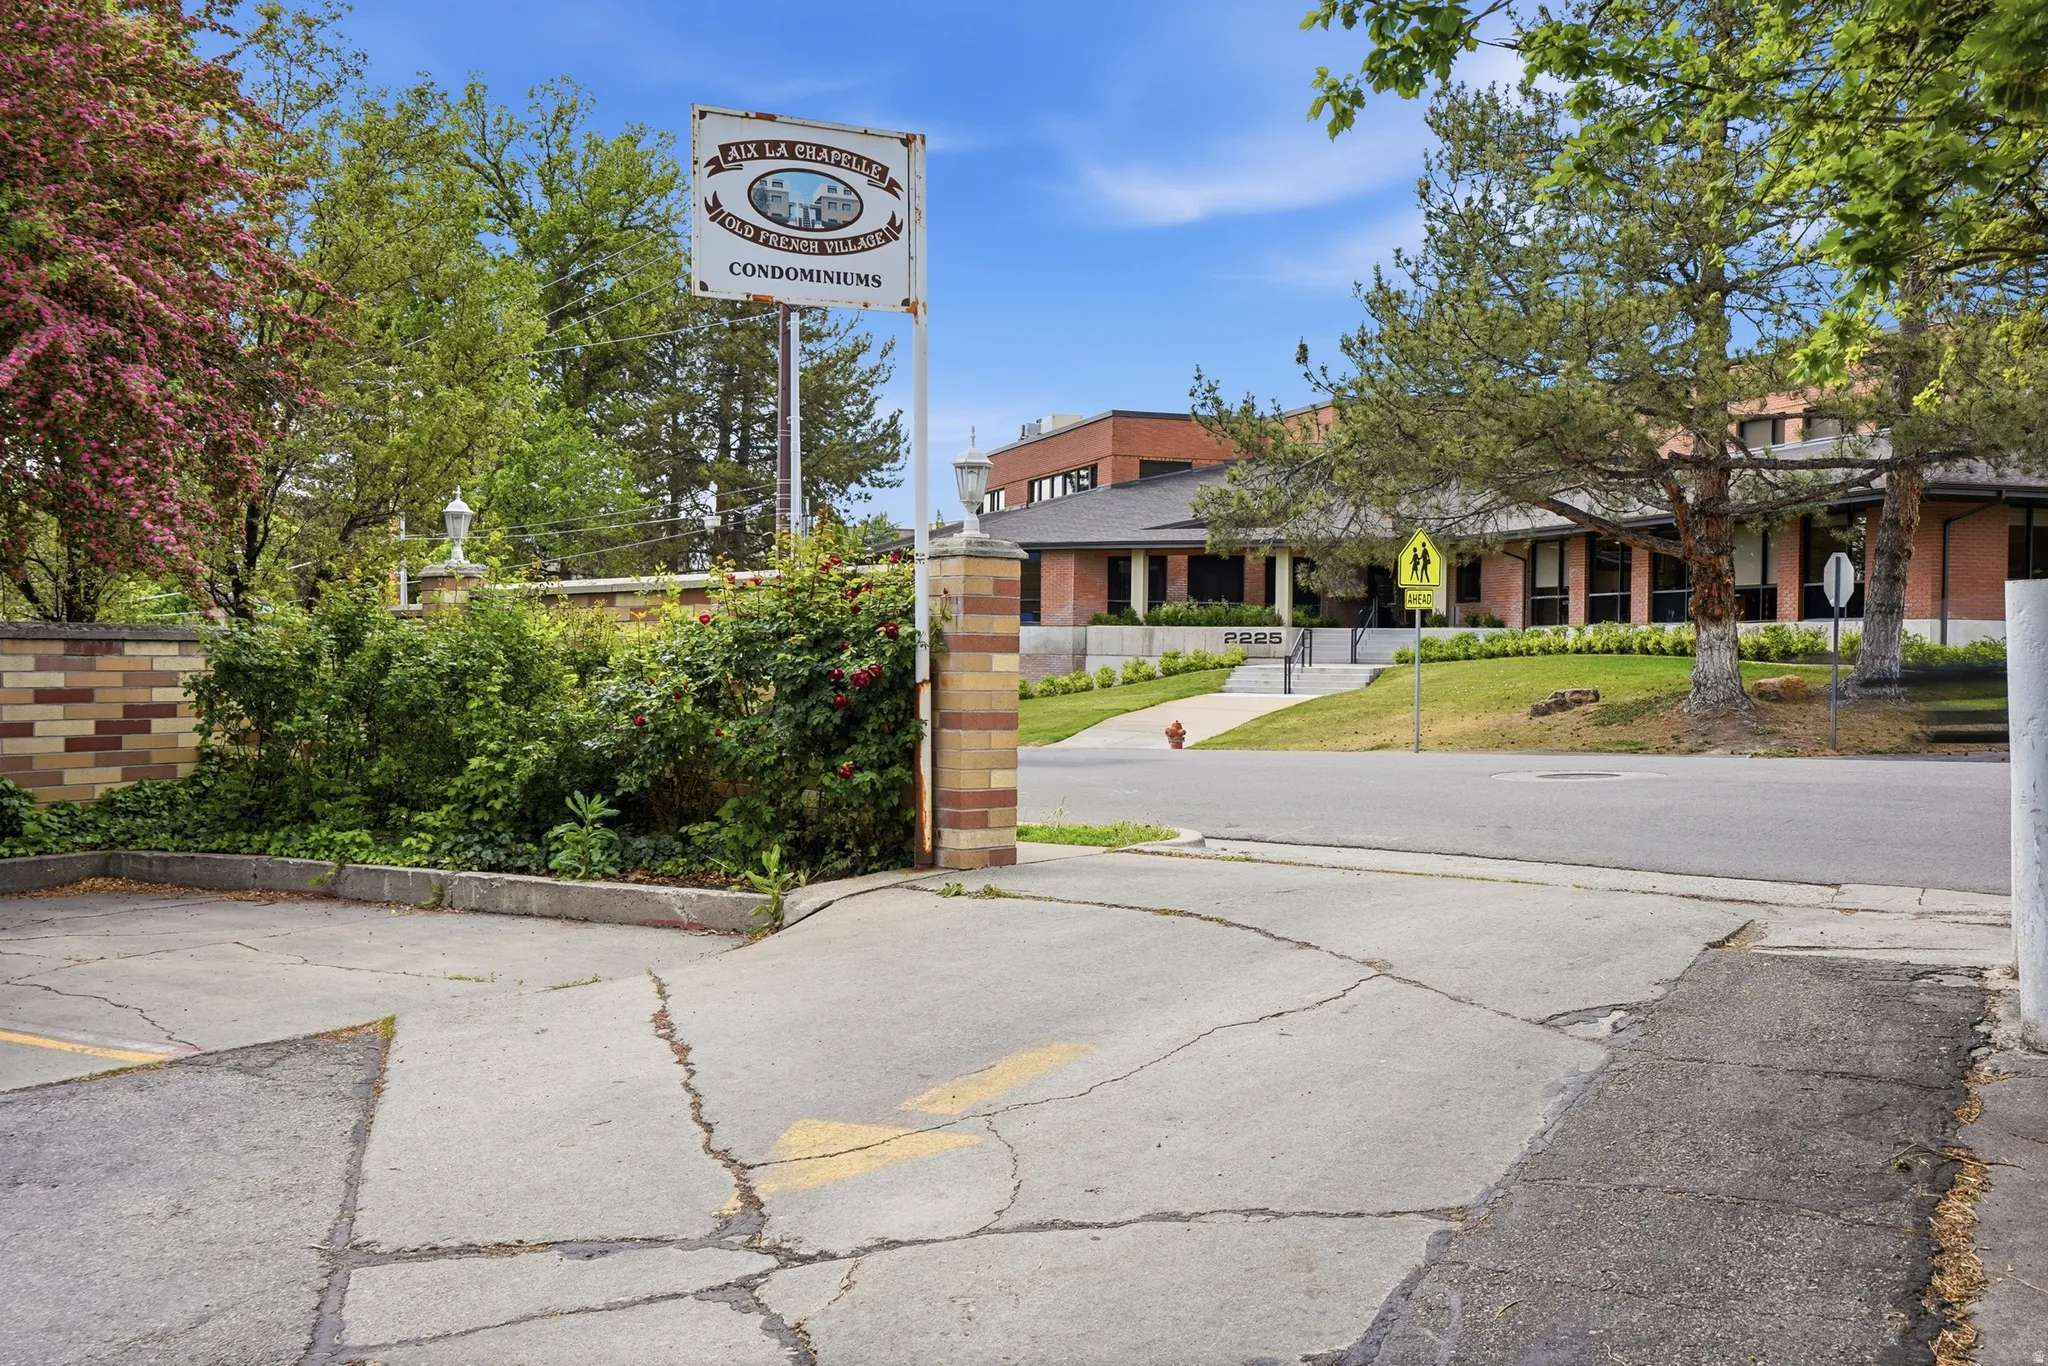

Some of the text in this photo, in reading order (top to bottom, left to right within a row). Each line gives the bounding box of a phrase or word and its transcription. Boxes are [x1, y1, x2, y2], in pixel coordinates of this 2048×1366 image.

[727, 142, 882, 180] AIX LA CHAPELLE
[724, 215, 885, 254] OLD FRENCH VILLAGE
[728, 261, 882, 288] CONDOMINIUMS
[1407, 593, 1432, 605] AHEAD
[1223, 631, 1283, 645] 2225
